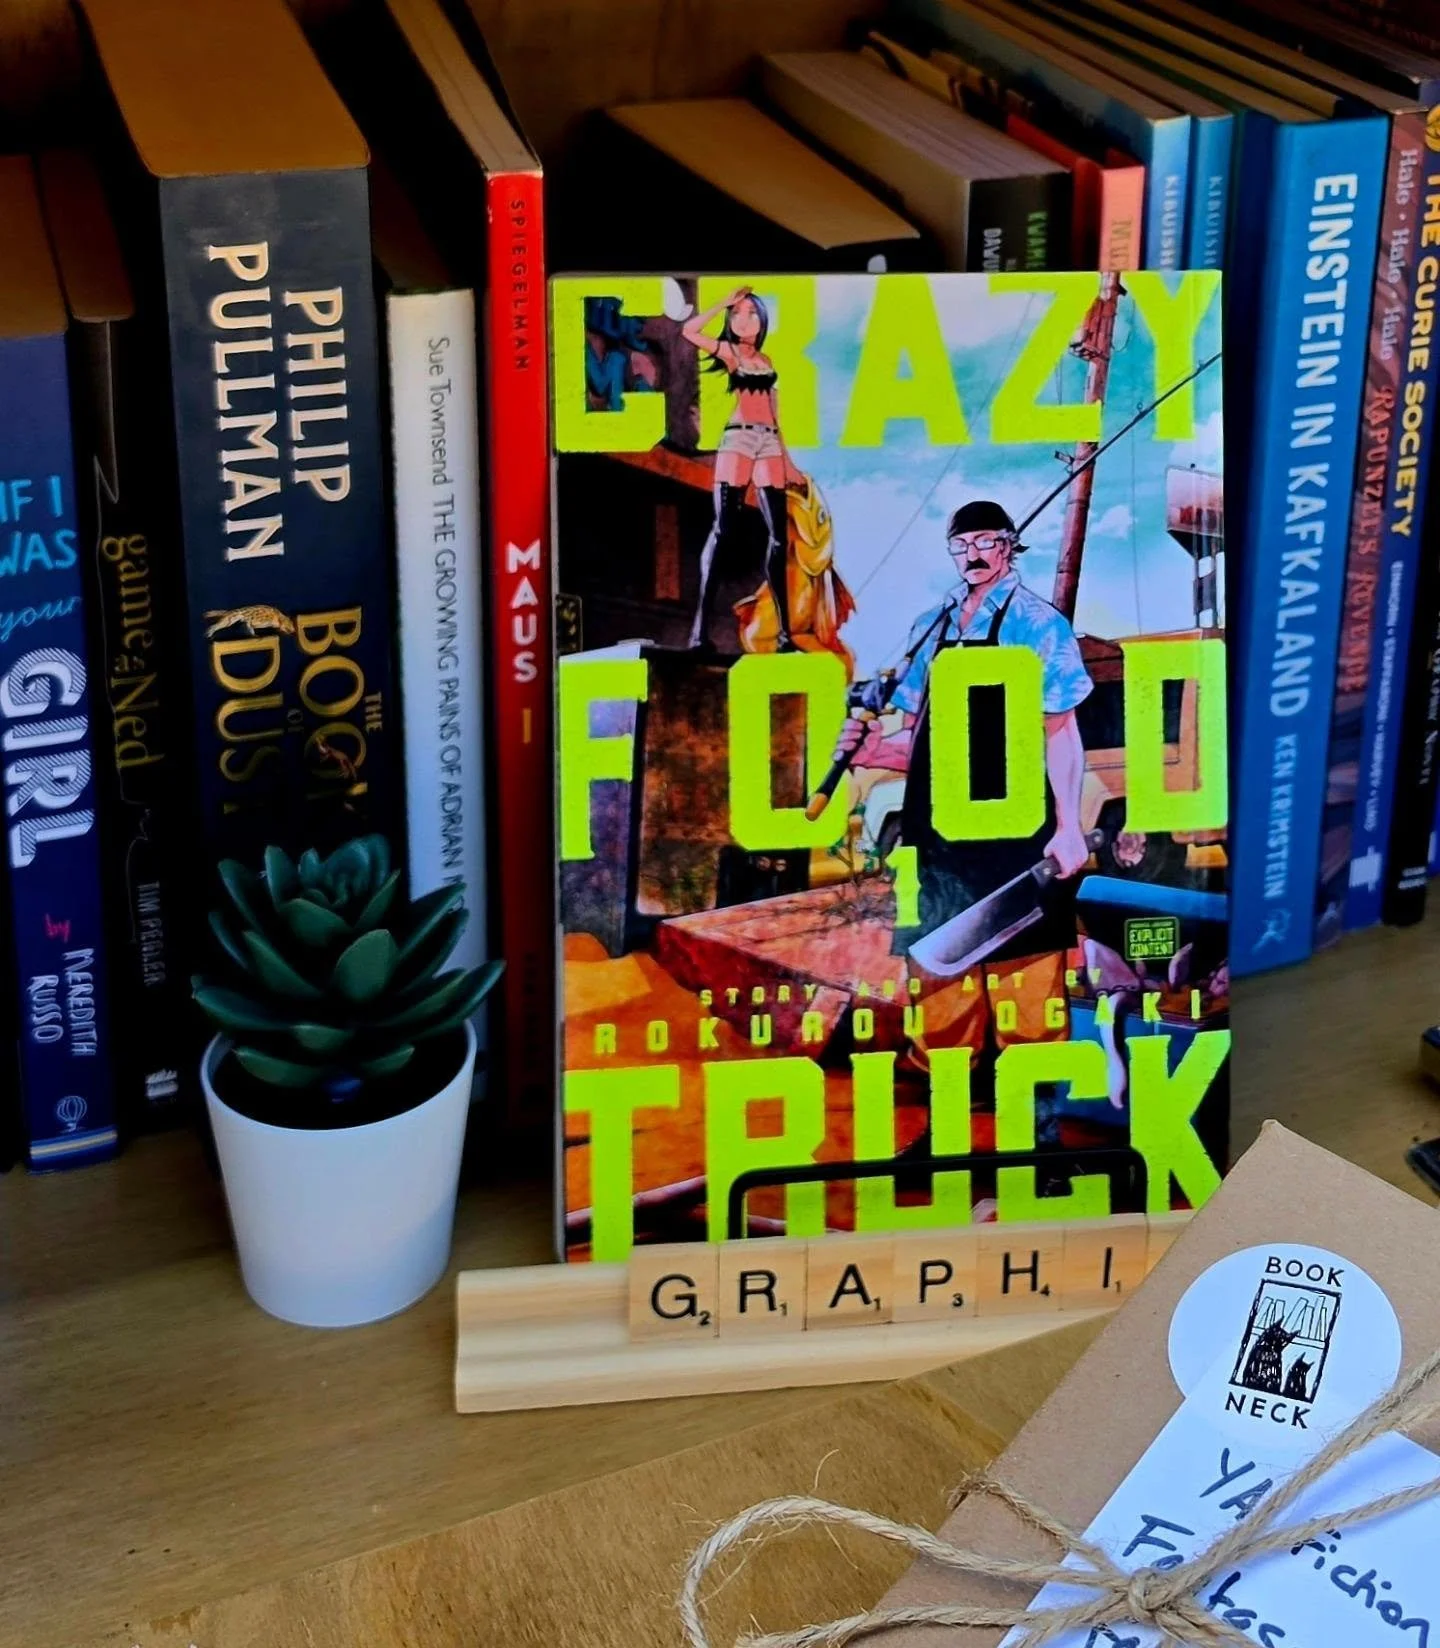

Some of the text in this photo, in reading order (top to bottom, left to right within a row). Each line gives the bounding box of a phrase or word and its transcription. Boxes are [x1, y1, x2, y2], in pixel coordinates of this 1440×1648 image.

[509, 199, 529, 371] SPIEGELMAN
[1407, 256, 1439, 372] CURIE
[208, 241, 285, 562] PULLMAN
[284, 286, 351, 502] PHILIP
[428, 337, 450, 376] Sue
[554, 272, 1222, 453] CRAZY
[430, 378, 453, 486] Townsend
[1269, 173, 1358, 718] EINSTEIN IN KAFKALAND
[1391, 381, 1426, 536] SOCIETY
[0, 475, 63, 523] IF I
[433, 494, 455, 543] THE
[0, 596, 82, 642] your
[102, 532, 152, 649] game
[435, 548, 458, 671] GROWING
[506, 539, 541, 683] MAUS
[0, 647, 96, 869] GIRL
[111, 671, 164, 769] Ned
[211, 635, 284, 814] DUS
[365, 691, 383, 734] THE
[438, 677, 461, 741] PAINS
[440, 744, 461, 776] OF
[559, 639, 1227, 860] FOOD
[440, 781, 464, 868] ADRIAN
[1263, 733, 1297, 899] KEN KRIMSTEIN
[884, 846, 921, 928] 1
[27, 974, 64, 1044] RUSSO
[63, 947, 98, 1057] MEREDITH
[595, 988, 1202, 1054] ROKUROU OGAKI
[699, 968, 1102, 1006] STORY AND ART BY
[563, 1029, 1230, 1262] TRUCK
[1264, 1256, 1345, 1288] BOOK
[1224, 1391, 1312, 1430] NECK
[1199, 1447, 1273, 1520] YA
